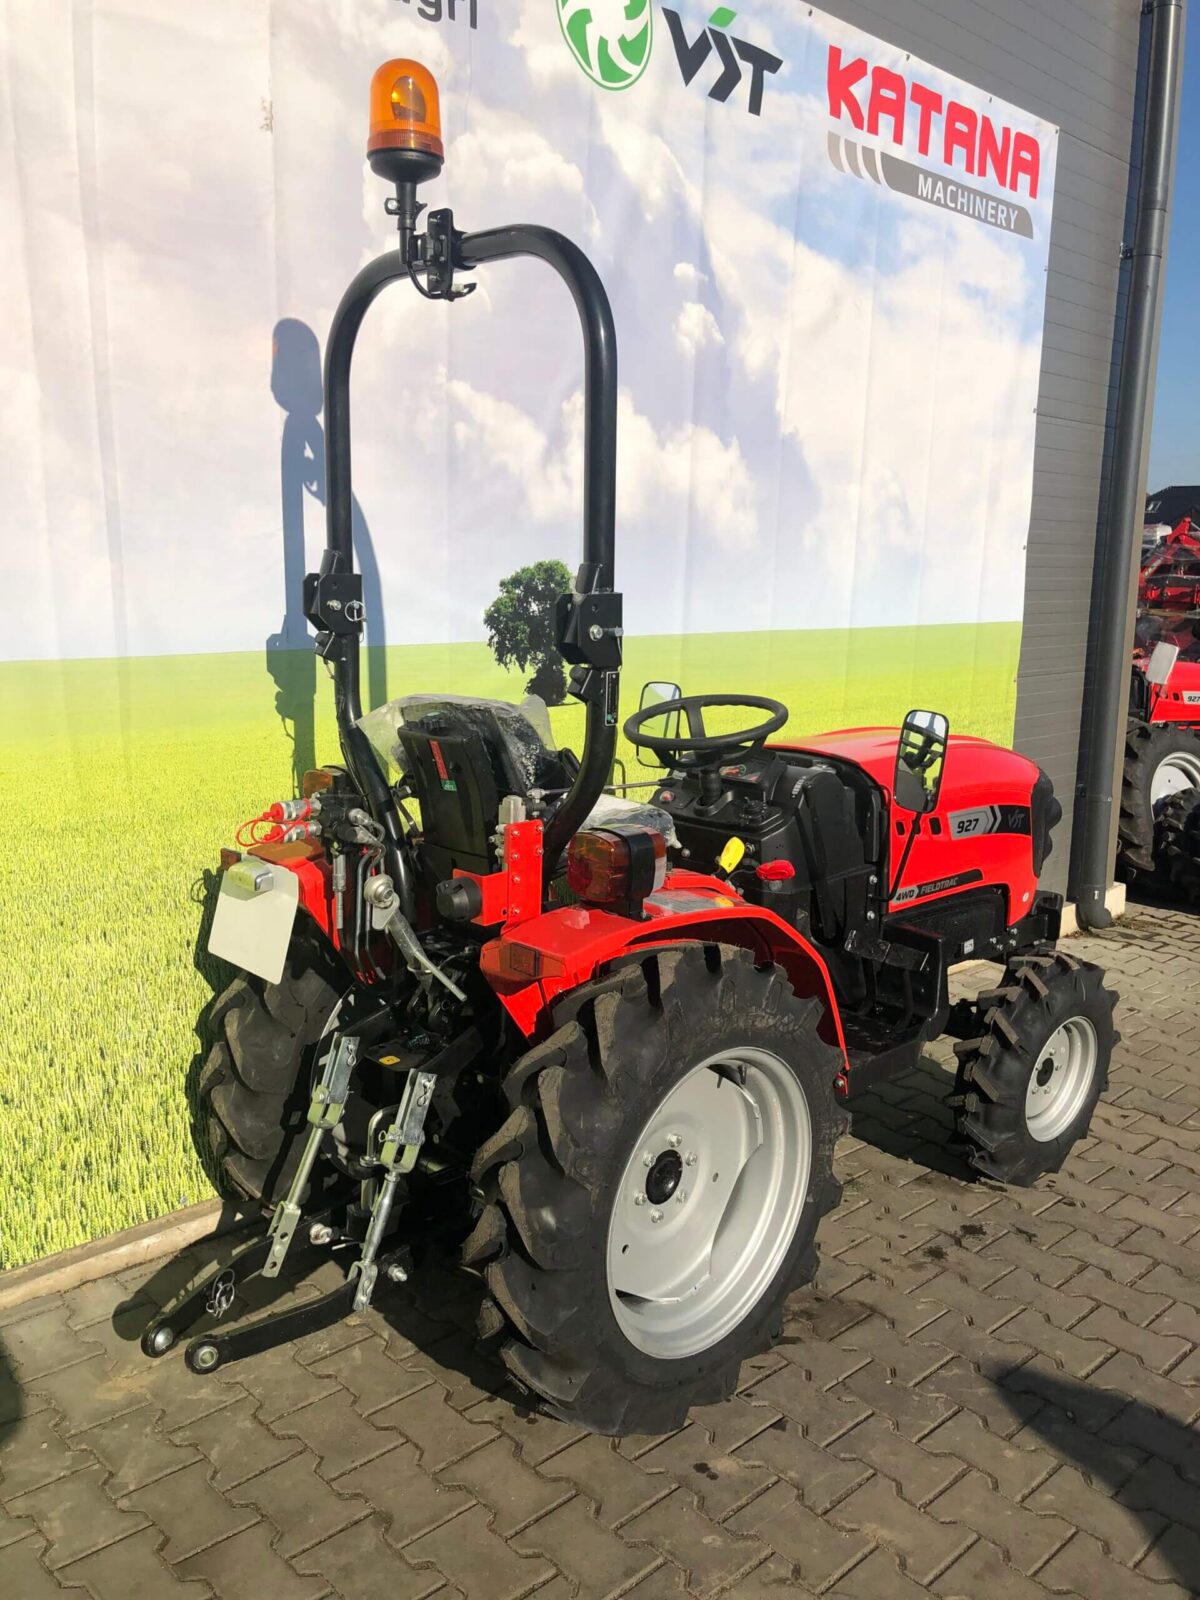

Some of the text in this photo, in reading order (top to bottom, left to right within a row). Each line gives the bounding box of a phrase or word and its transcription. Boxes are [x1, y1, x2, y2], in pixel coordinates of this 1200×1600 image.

[826, 44, 1041, 200] KATANA
[917, 173, 1019, 230] MACHINERY
[957, 818, 980, 834] 927
[896, 878, 959, 901] 4WD FIELDTRAC
